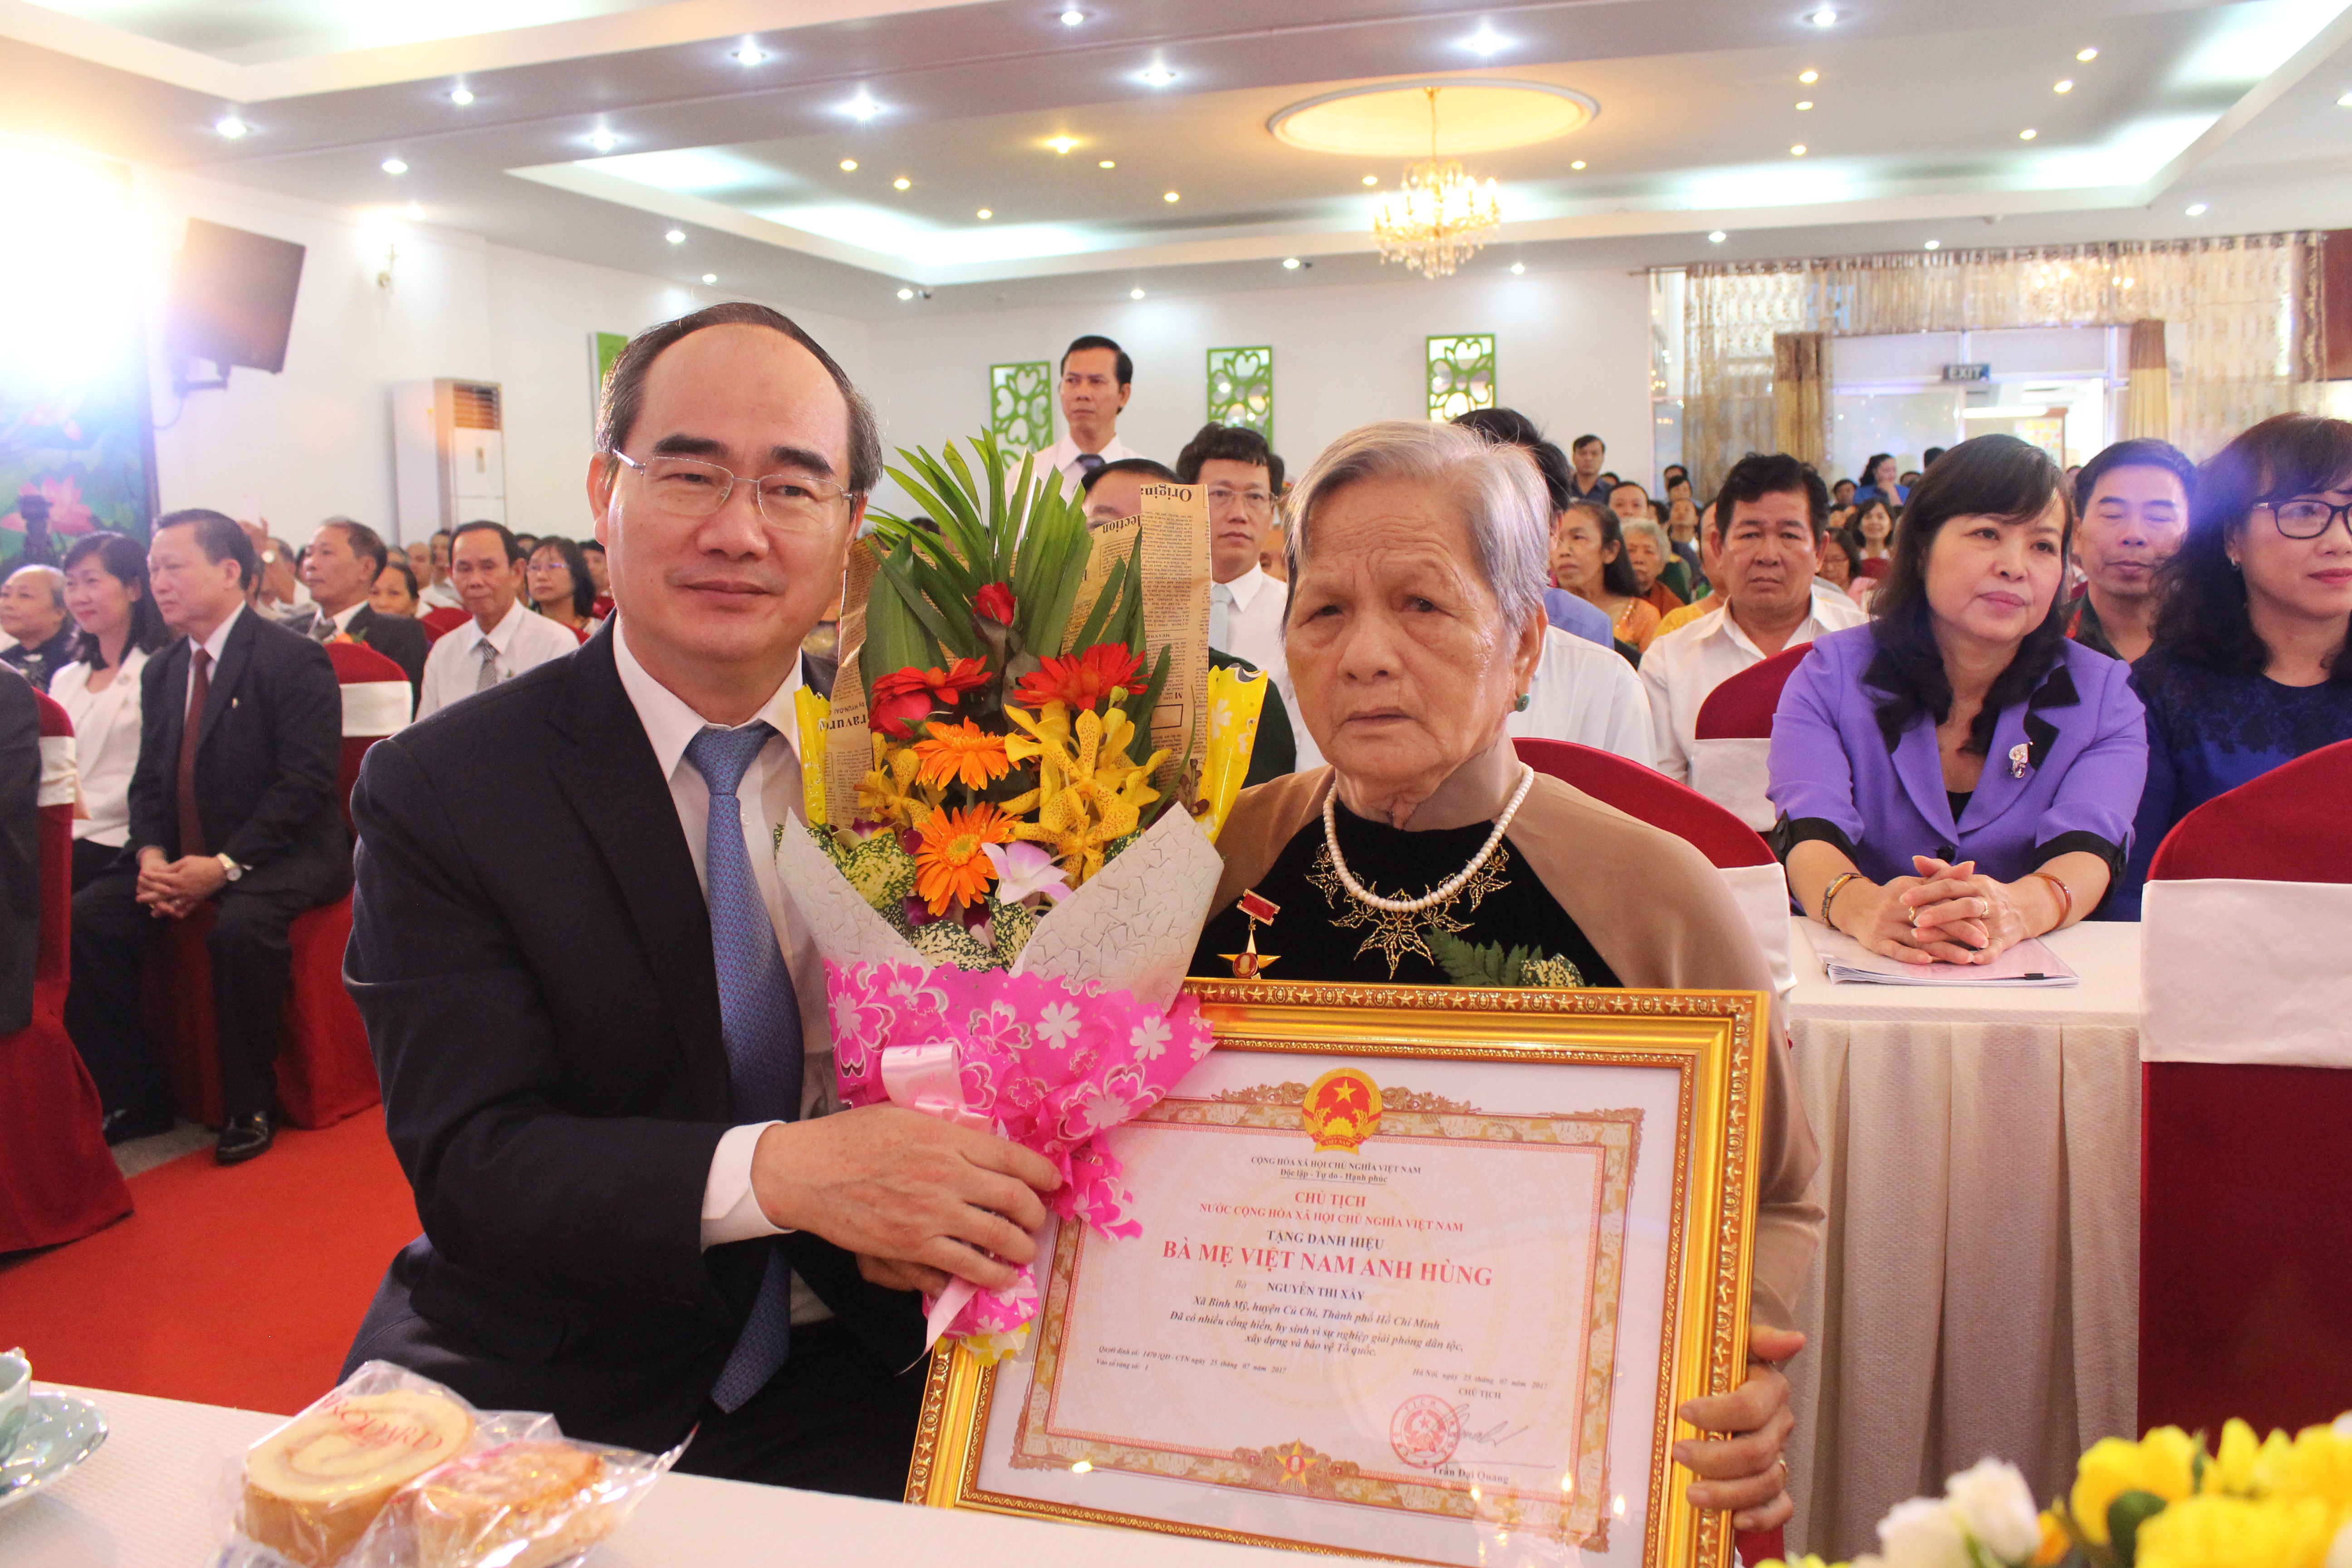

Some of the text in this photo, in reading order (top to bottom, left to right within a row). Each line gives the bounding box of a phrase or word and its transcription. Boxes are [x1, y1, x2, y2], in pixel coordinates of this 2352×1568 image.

[1950, 367, 1981, 379] EXIT
[1102, 515, 1142, 533] lection
[834, 704, 858, 714] HYUN-DAI
[826, 714, 867, 730] ravur
[1251, 1156, 1275, 1165] CỘNG
[1277, 1157, 1295, 1166] HÒA
[1298, 1158, 1308, 1167] XÃ
[1310, 1160, 1326, 1168] HỘI
[1379, 1164, 1399, 1174] VIỆT
[1401, 1166, 1421, 1174] NAM
[1280, 1168, 1295, 1177] Độc
[1296, 1169, 1308, 1179] lập
[1316, 1170, 1326, 1180] Tự
[1345, 1173, 1367, 1183] Hạnh
[1368, 1175, 1388, 1185] phúc
[1294, 1189, 1366, 1209] CHỦ TỊCH
[1199, 1202, 1464, 1232] NƯỚC CỘNG HÒA XÃ HỘI CHỦ NGHĨA VIỆT NAM
[1267, 1229, 1385, 1251] TẶNG DANH HIỆU
[1162, 1237, 1493, 1287] BÀ MẸ VIỆT NAM ANH HÙNG
[1235, 1279, 1365, 1301] Bà NGUYỄN THỊ XÂY
[1193, 1296, 1206, 1306] Xã
[1208, 1297, 1231, 1308] Bình
[1252, 1303, 1281, 1315] huyện
[1283, 1305, 1297, 1316] Củ
[1322, 1308, 1353, 1321] Thành
[1354, 1311, 1374, 1324] phố
[1376, 1313, 1392, 1324] Hồ
[1413, 1318, 1441, 1330] Minh
[1169, 1310, 1464, 1352] Đã có nhiều cống hiến, hy sinh vì sự nghiệp giải phóng dân tộc,
[1245, 1334, 1377, 1357] xây dựng và bảo vệ Tổ quốc.
[1220, 1360, 1238, 1370] tháng
[1458, 1387, 1502, 1400] CHỦ TỊCH
[1458, 1467, 1475, 1480] Đại
[1477, 1470, 1509, 1485] Quang
